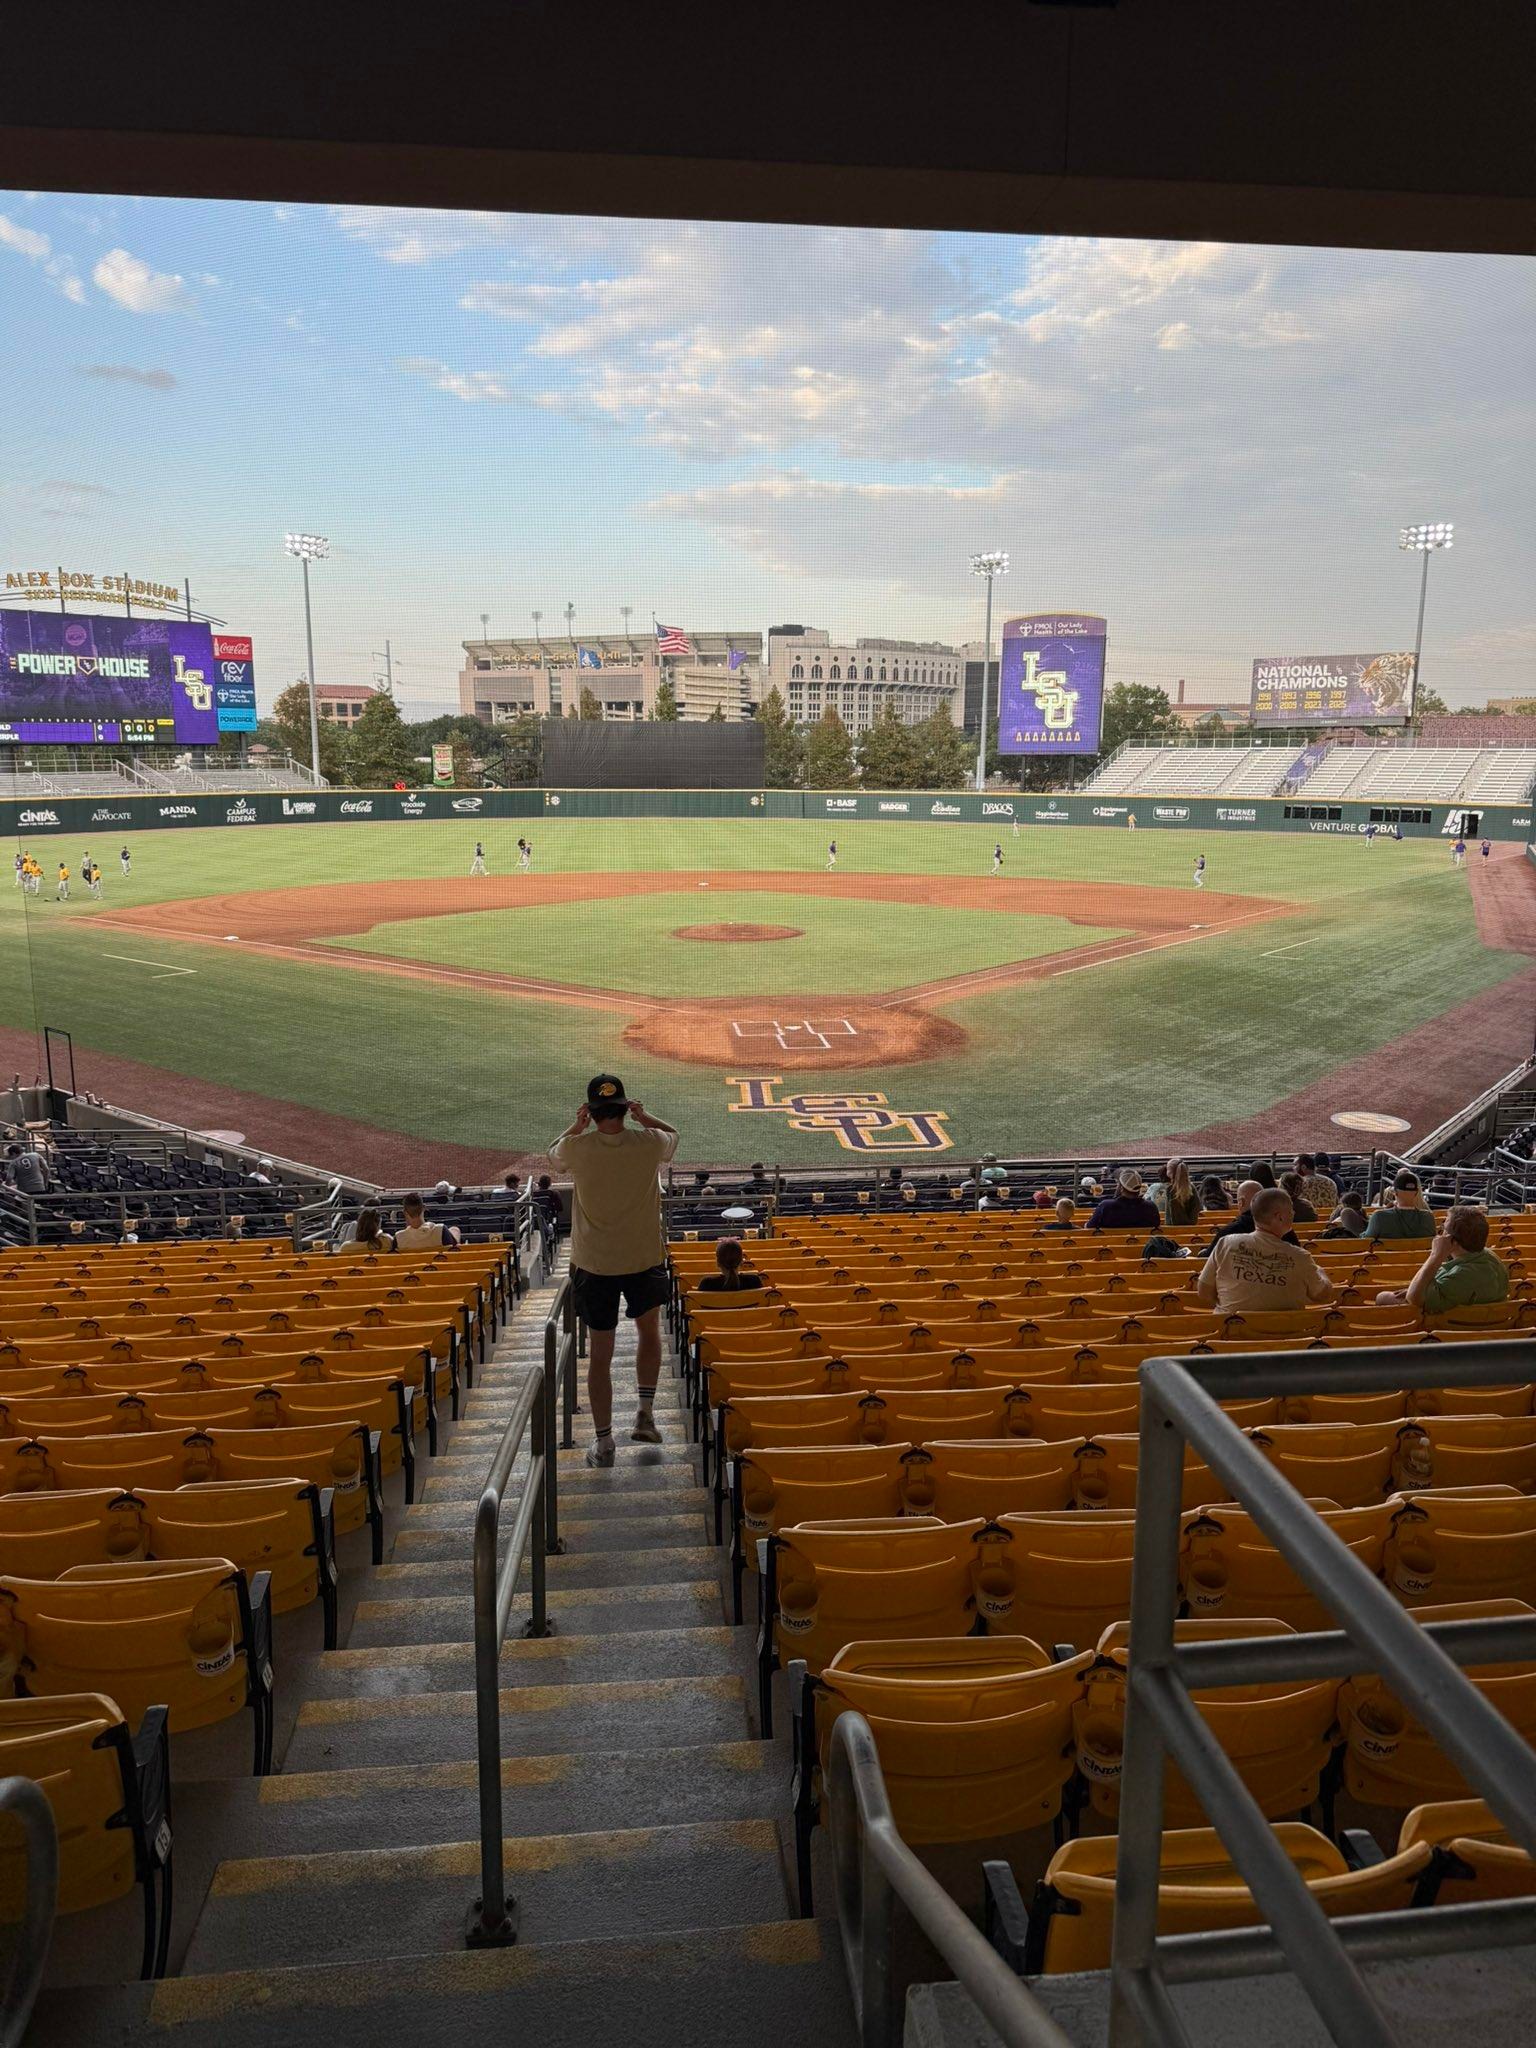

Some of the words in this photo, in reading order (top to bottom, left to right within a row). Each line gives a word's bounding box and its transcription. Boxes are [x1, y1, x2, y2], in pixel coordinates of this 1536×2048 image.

[6, 571, 52, 589] ALEX
[59, 572, 96, 588] BOX
[102, 575, 179, 602] STADIUM
[17, 653, 76, 675] POWER
[98, 657, 150, 678] HOUSE
[221, 662, 246, 674] rev
[1258, 665, 1332, 679] NATIONAL
[173, 655, 213, 711] LSU
[1021, 651, 1078, 729] LSU
[1257, 676, 1348, 690] CHAMPIONS
[20, 809, 58, 822] CINTAS
[91, 812, 132, 821] ADVOCATE
[159, 806, 197, 816] MANDA
[1227, 808, 1257, 816] TURNER
[1310, 822, 1356, 831] VENTURE
[725, 1076, 955, 1153] LSU
[1234, 1265, 1287, 1286] Texas
